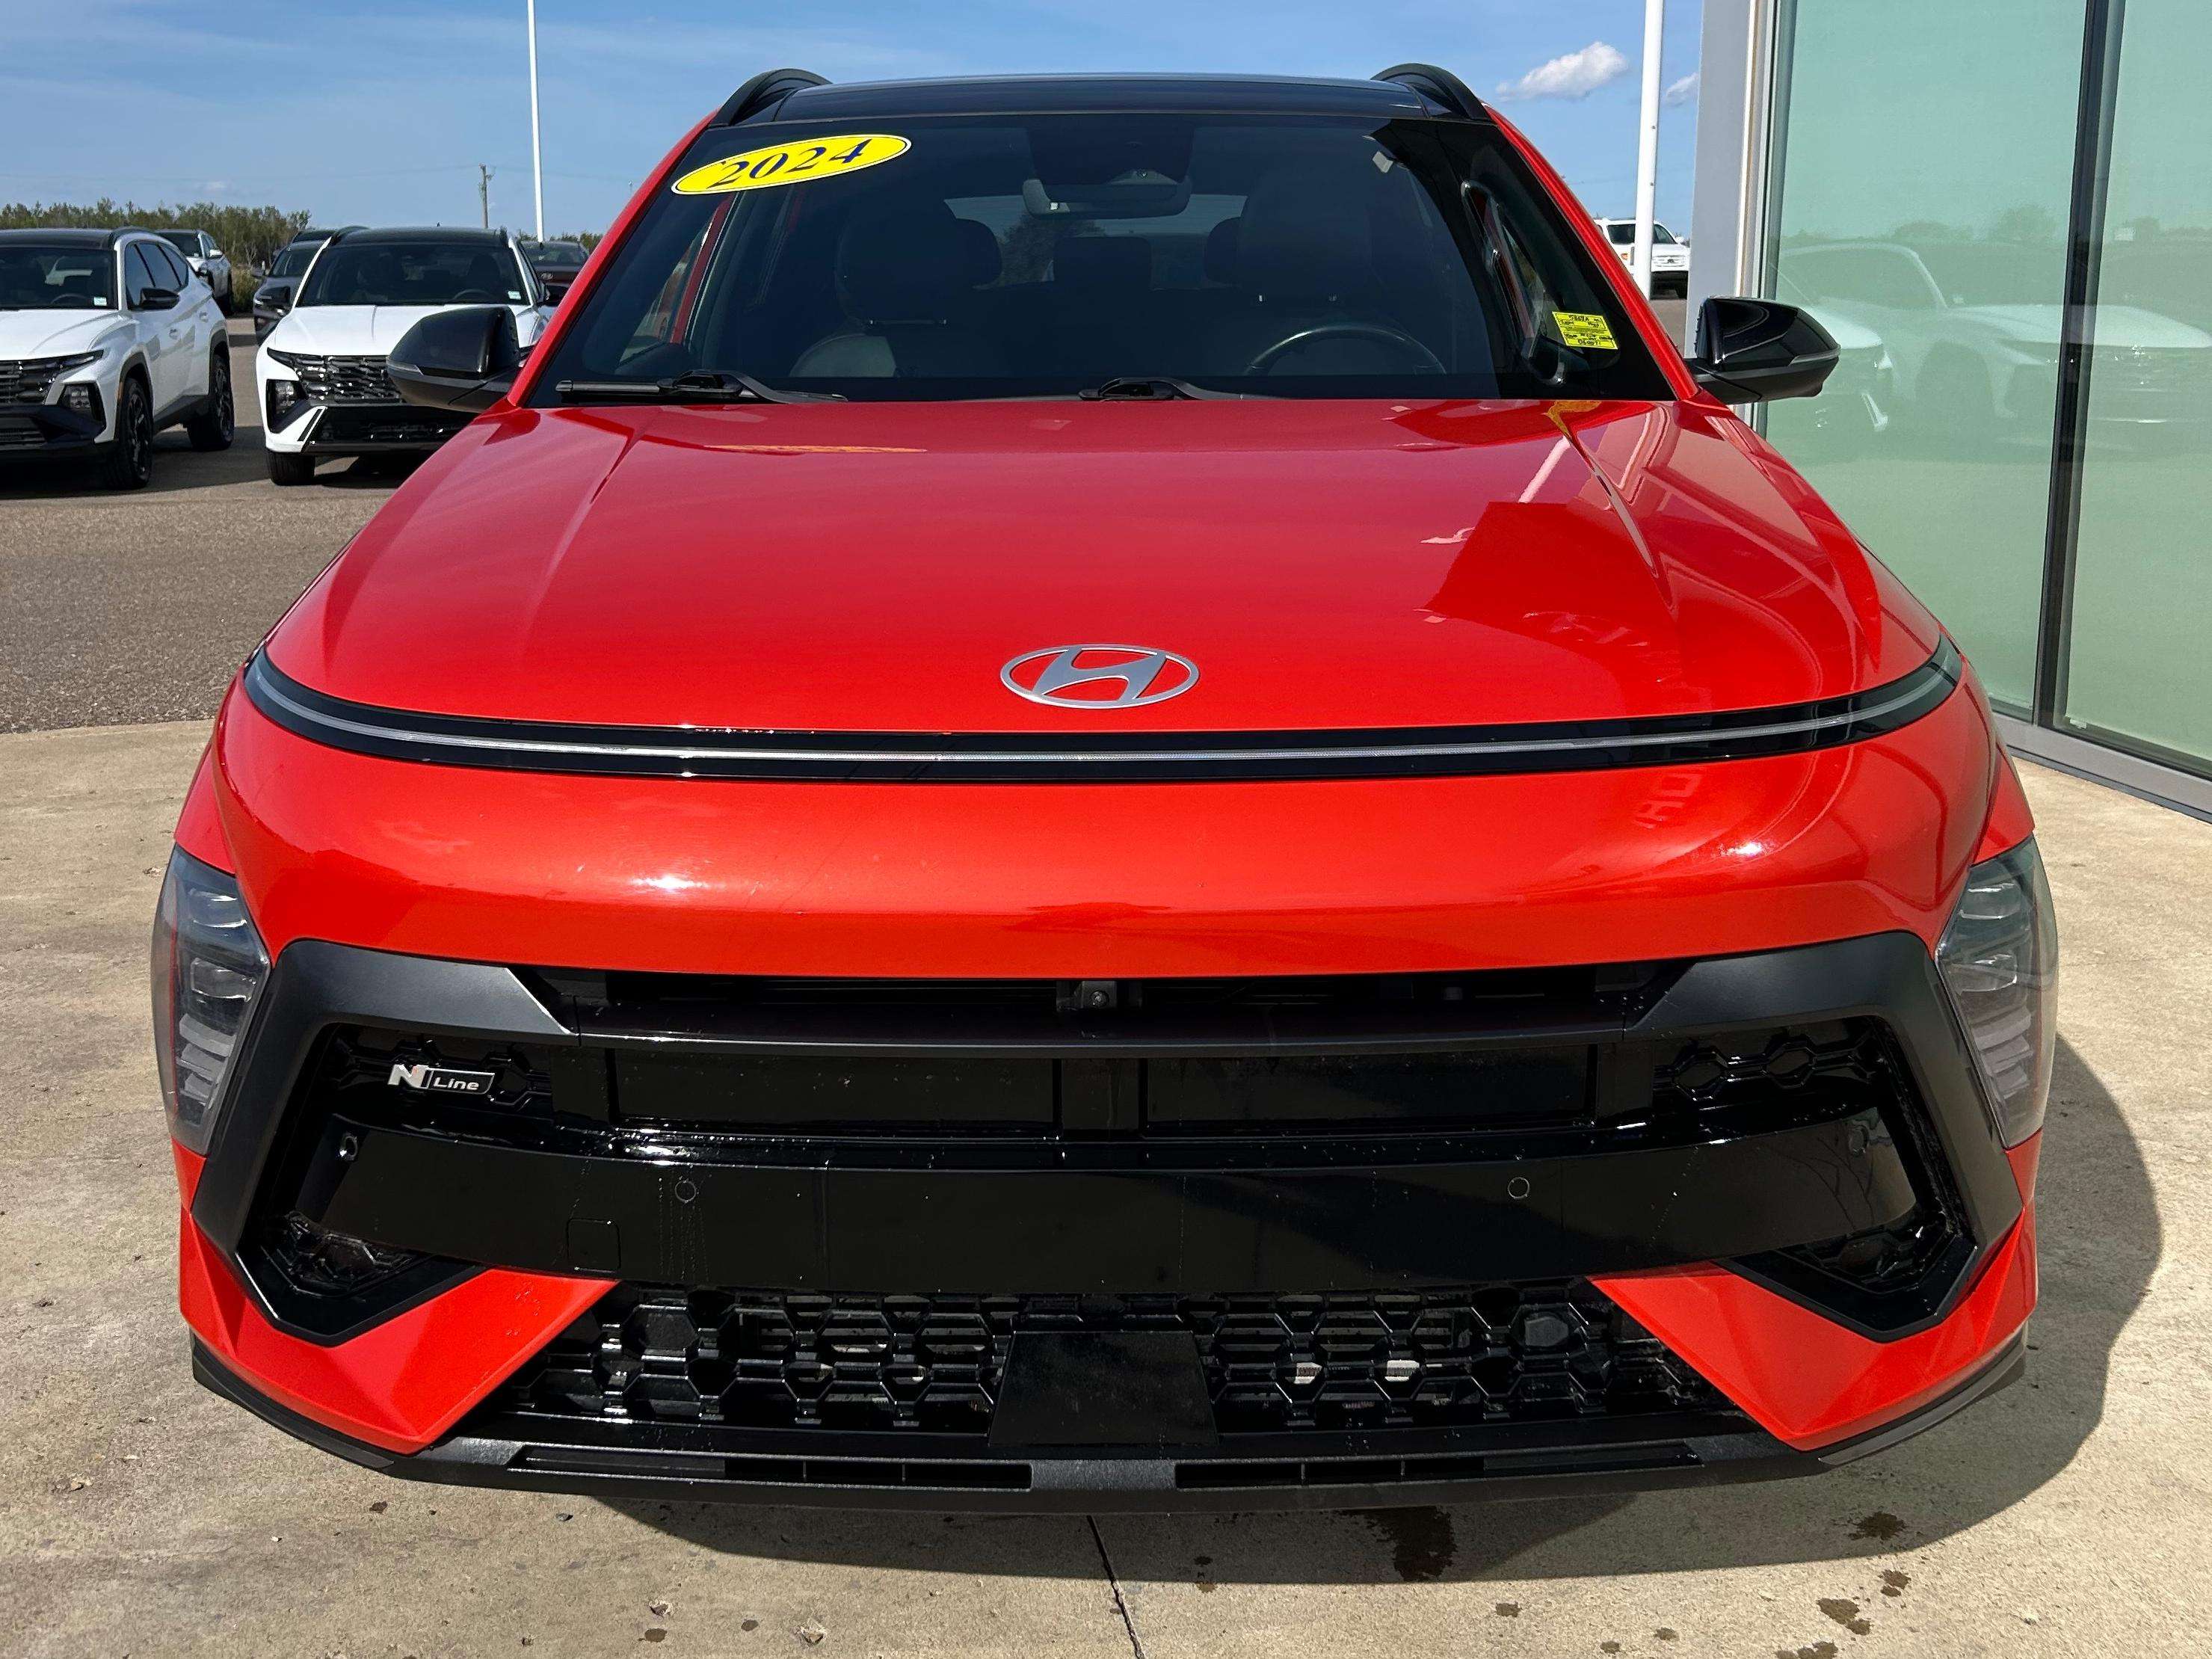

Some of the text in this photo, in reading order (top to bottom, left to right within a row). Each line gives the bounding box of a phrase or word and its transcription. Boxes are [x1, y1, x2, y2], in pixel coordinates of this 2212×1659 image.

[706, 138, 873, 189] 2024
[387, 1064, 479, 1090] N Line
